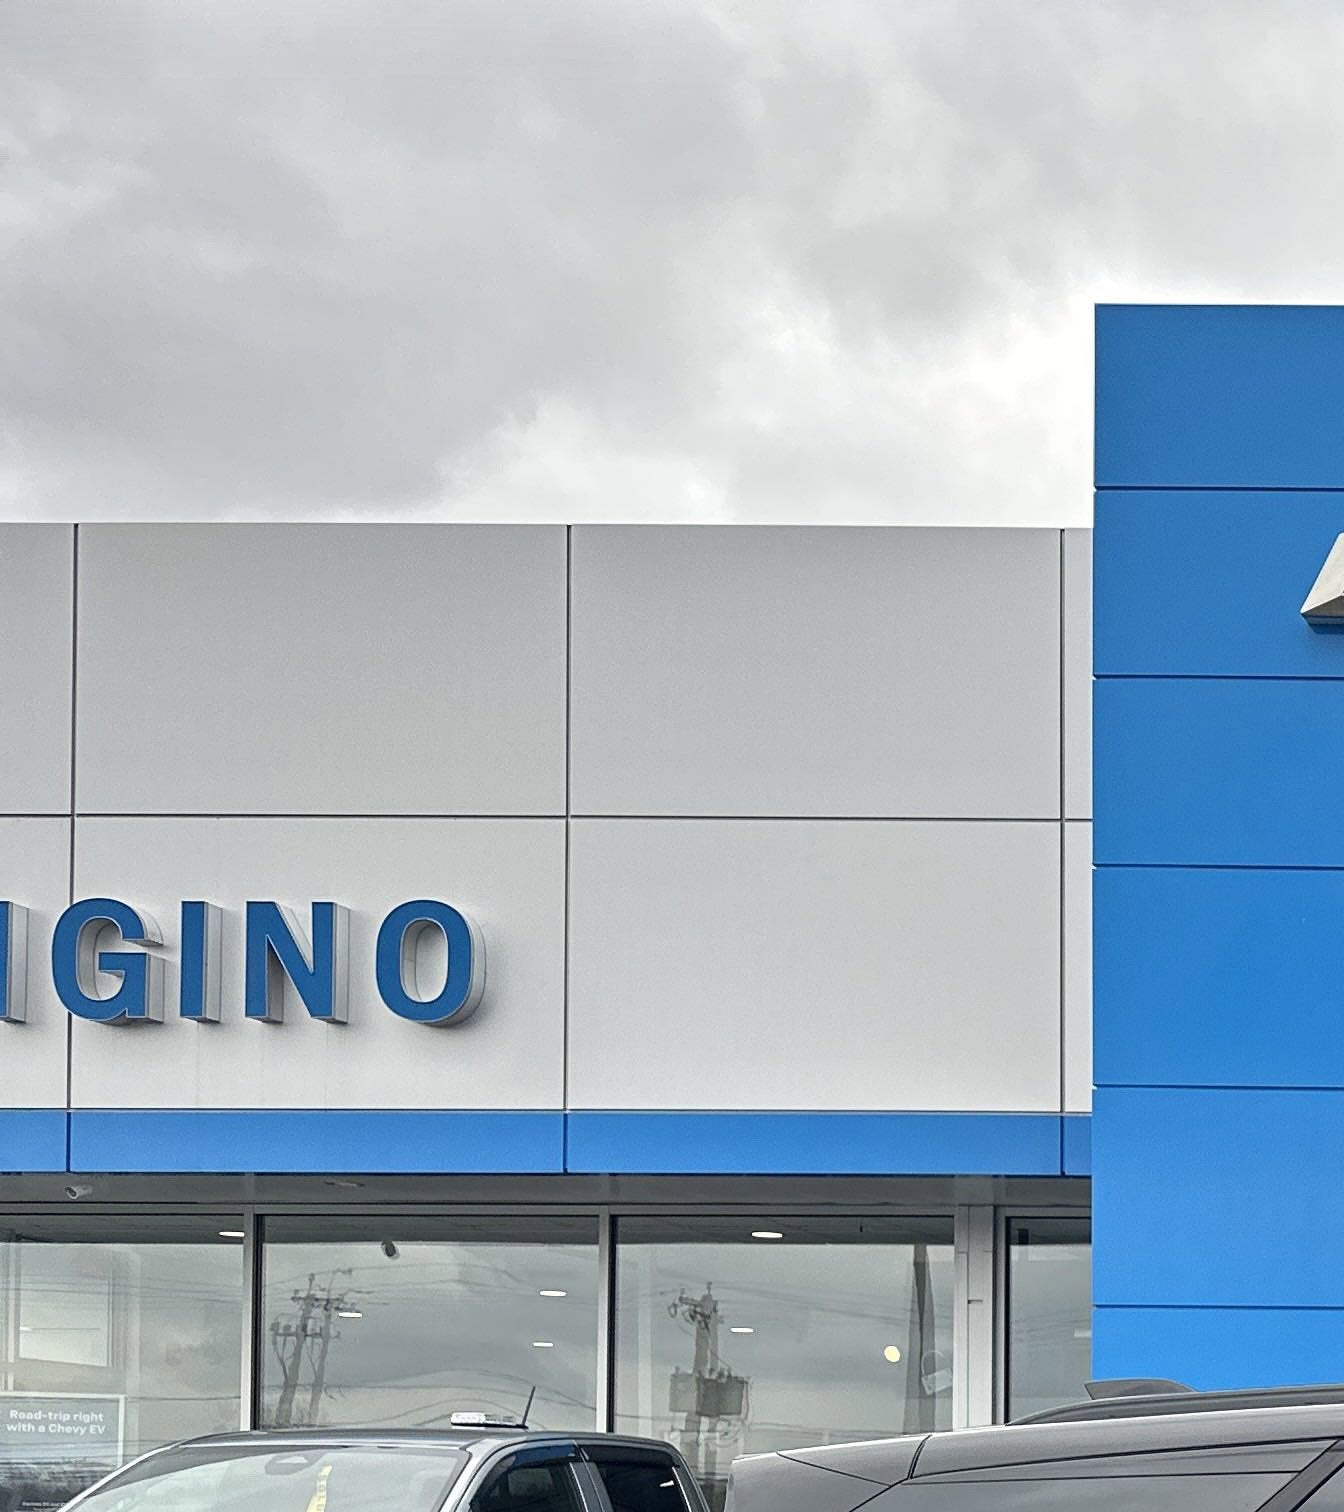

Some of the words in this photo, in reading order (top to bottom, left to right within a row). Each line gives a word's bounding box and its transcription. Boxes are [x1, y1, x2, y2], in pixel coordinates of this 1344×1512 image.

[10, 1409, 71, 1422] Road-trip
[73, 1411, 105, 1423] right
[6, 1422, 36, 1433] with
[38, 1425, 46, 1433] a
[48, 1423, 87, 1436] Chevy
[89, 1424, 106, 1435] EV
